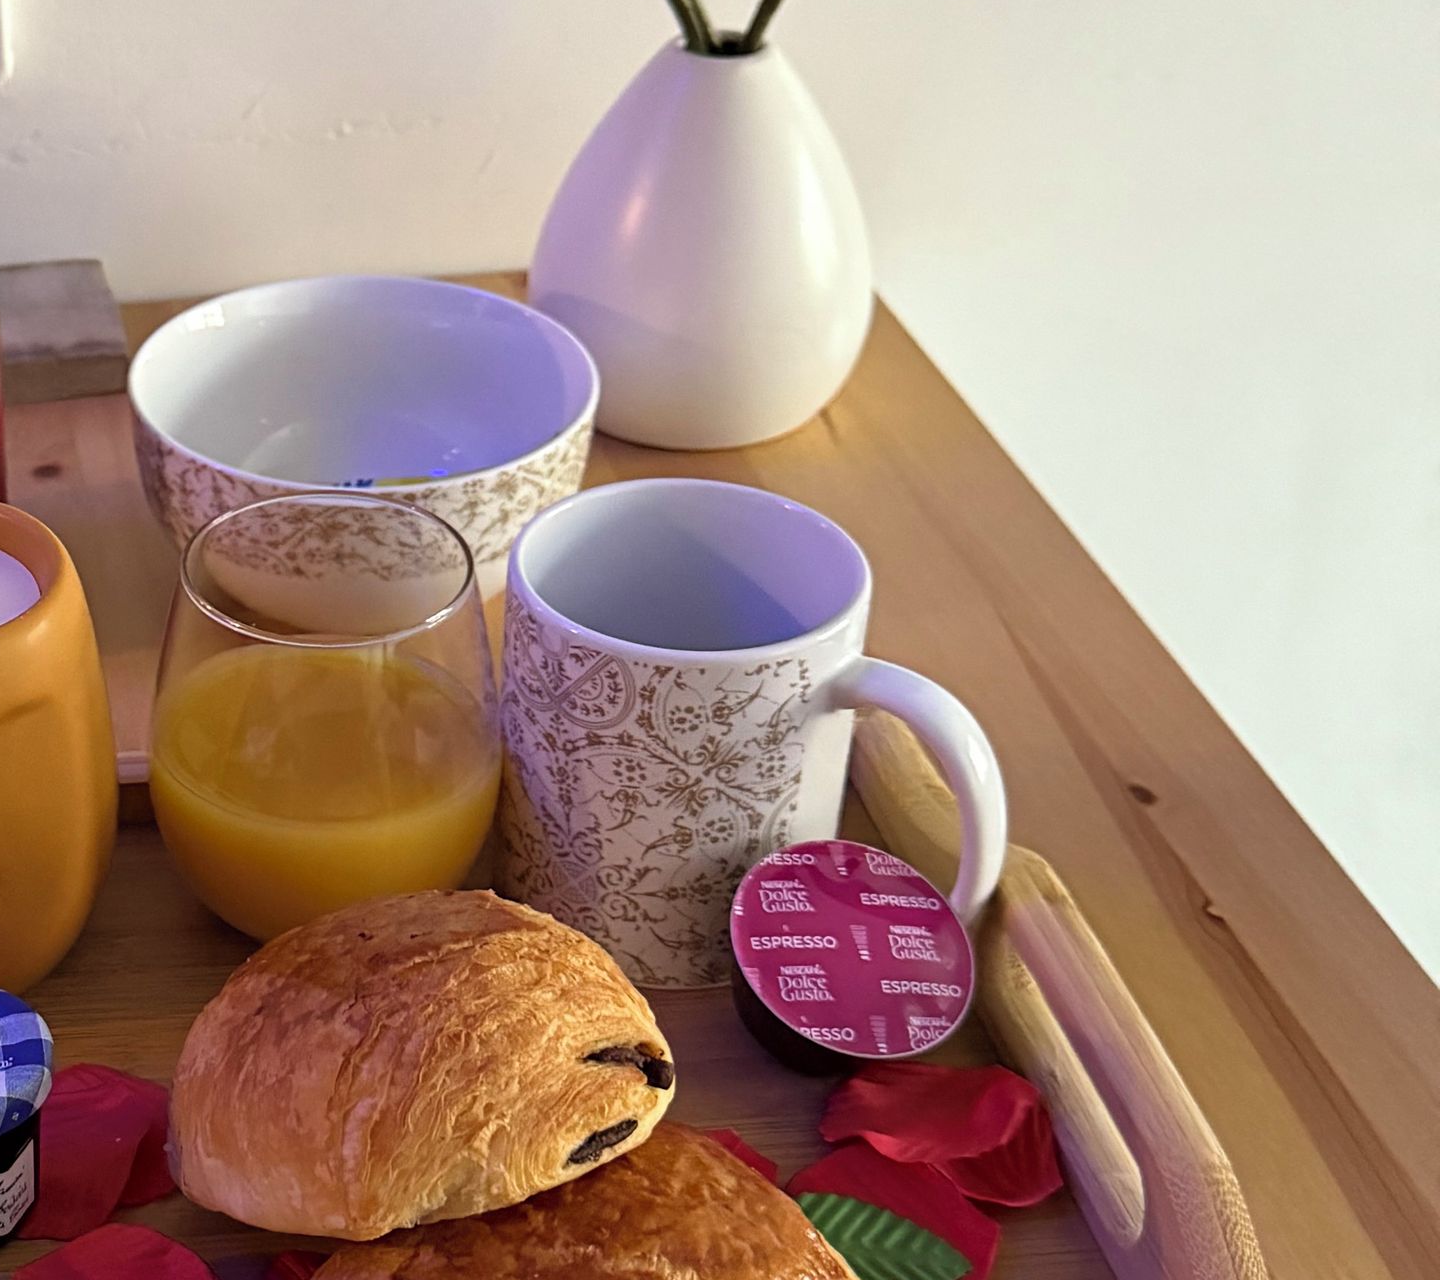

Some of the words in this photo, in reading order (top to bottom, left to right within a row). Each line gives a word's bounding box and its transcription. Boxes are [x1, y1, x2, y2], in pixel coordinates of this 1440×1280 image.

[758, 888, 810, 902] Dolce
[859, 892, 940, 911] ESPRESSO
[761, 898, 812, 913] Gusto
[750, 935, 837, 950] ESPRESSO
[887, 934, 935, 950] Dolce
[890, 945, 938, 961] Gusto
[777, 975, 827, 989] Dolce
[880, 980, 962, 997] ESPRESSO
[780, 986, 831, 1002] Gusto
[799, 1026, 855, 1041] RESSO
